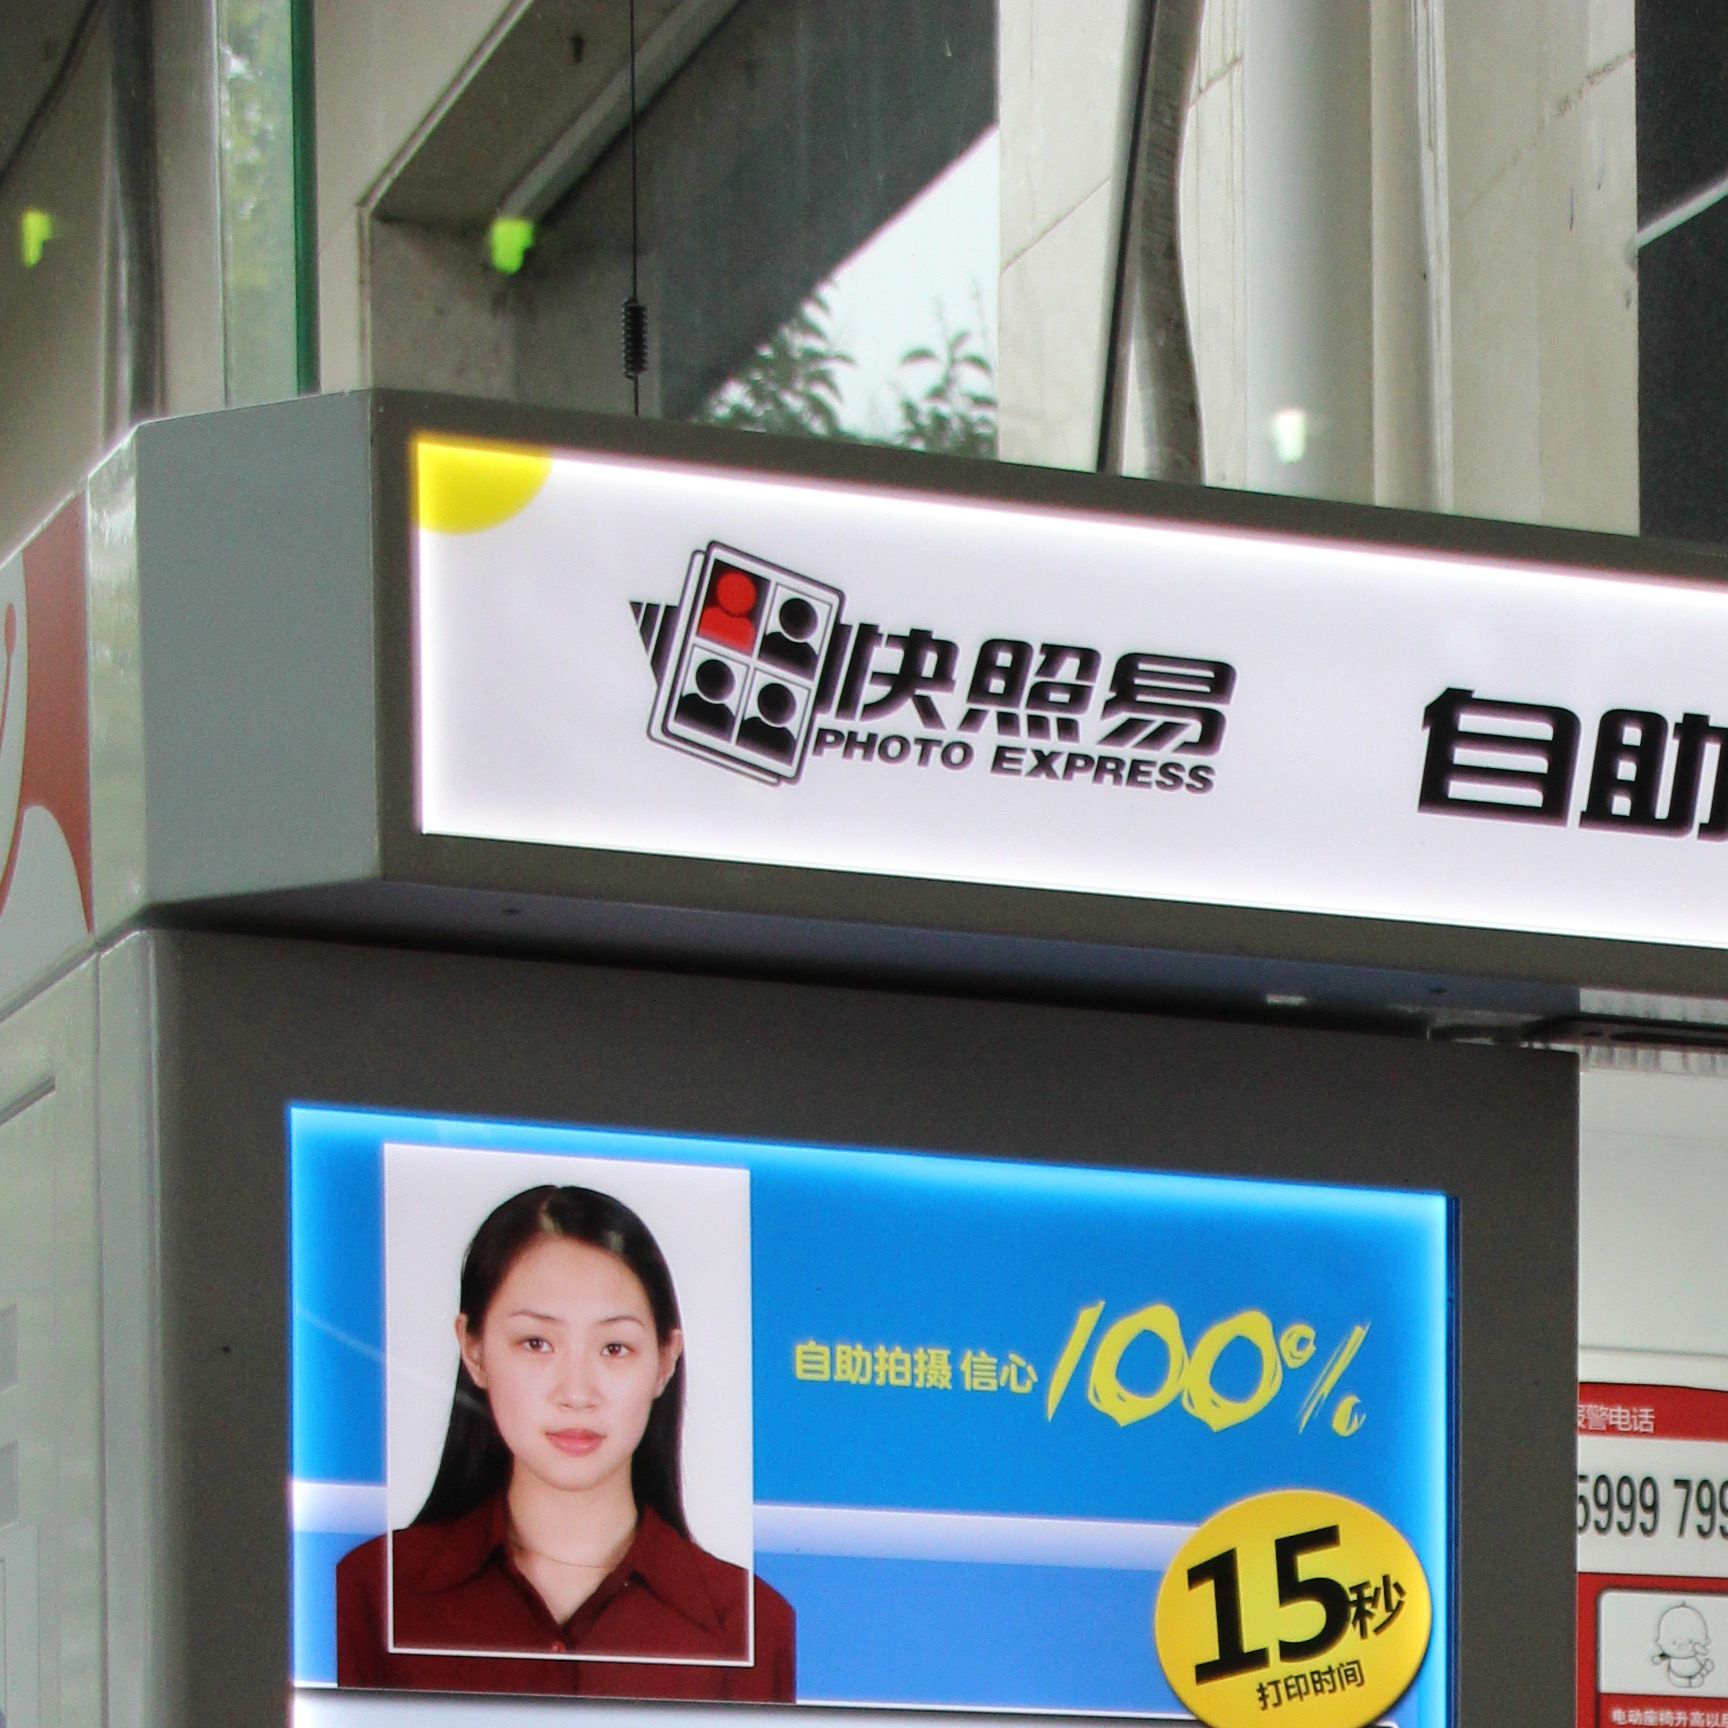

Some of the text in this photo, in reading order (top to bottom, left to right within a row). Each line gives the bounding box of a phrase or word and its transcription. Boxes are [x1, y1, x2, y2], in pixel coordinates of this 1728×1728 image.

[822, 624, 1237, 759] 快照易
[813, 728, 1215, 795] PHOTO EXPRESS
[793, 1341, 1038, 1394] 自助拍摄 信心
[1045, 1300, 1371, 1437] 100%
[1256, 1659, 1365, 1711] 打印时间
